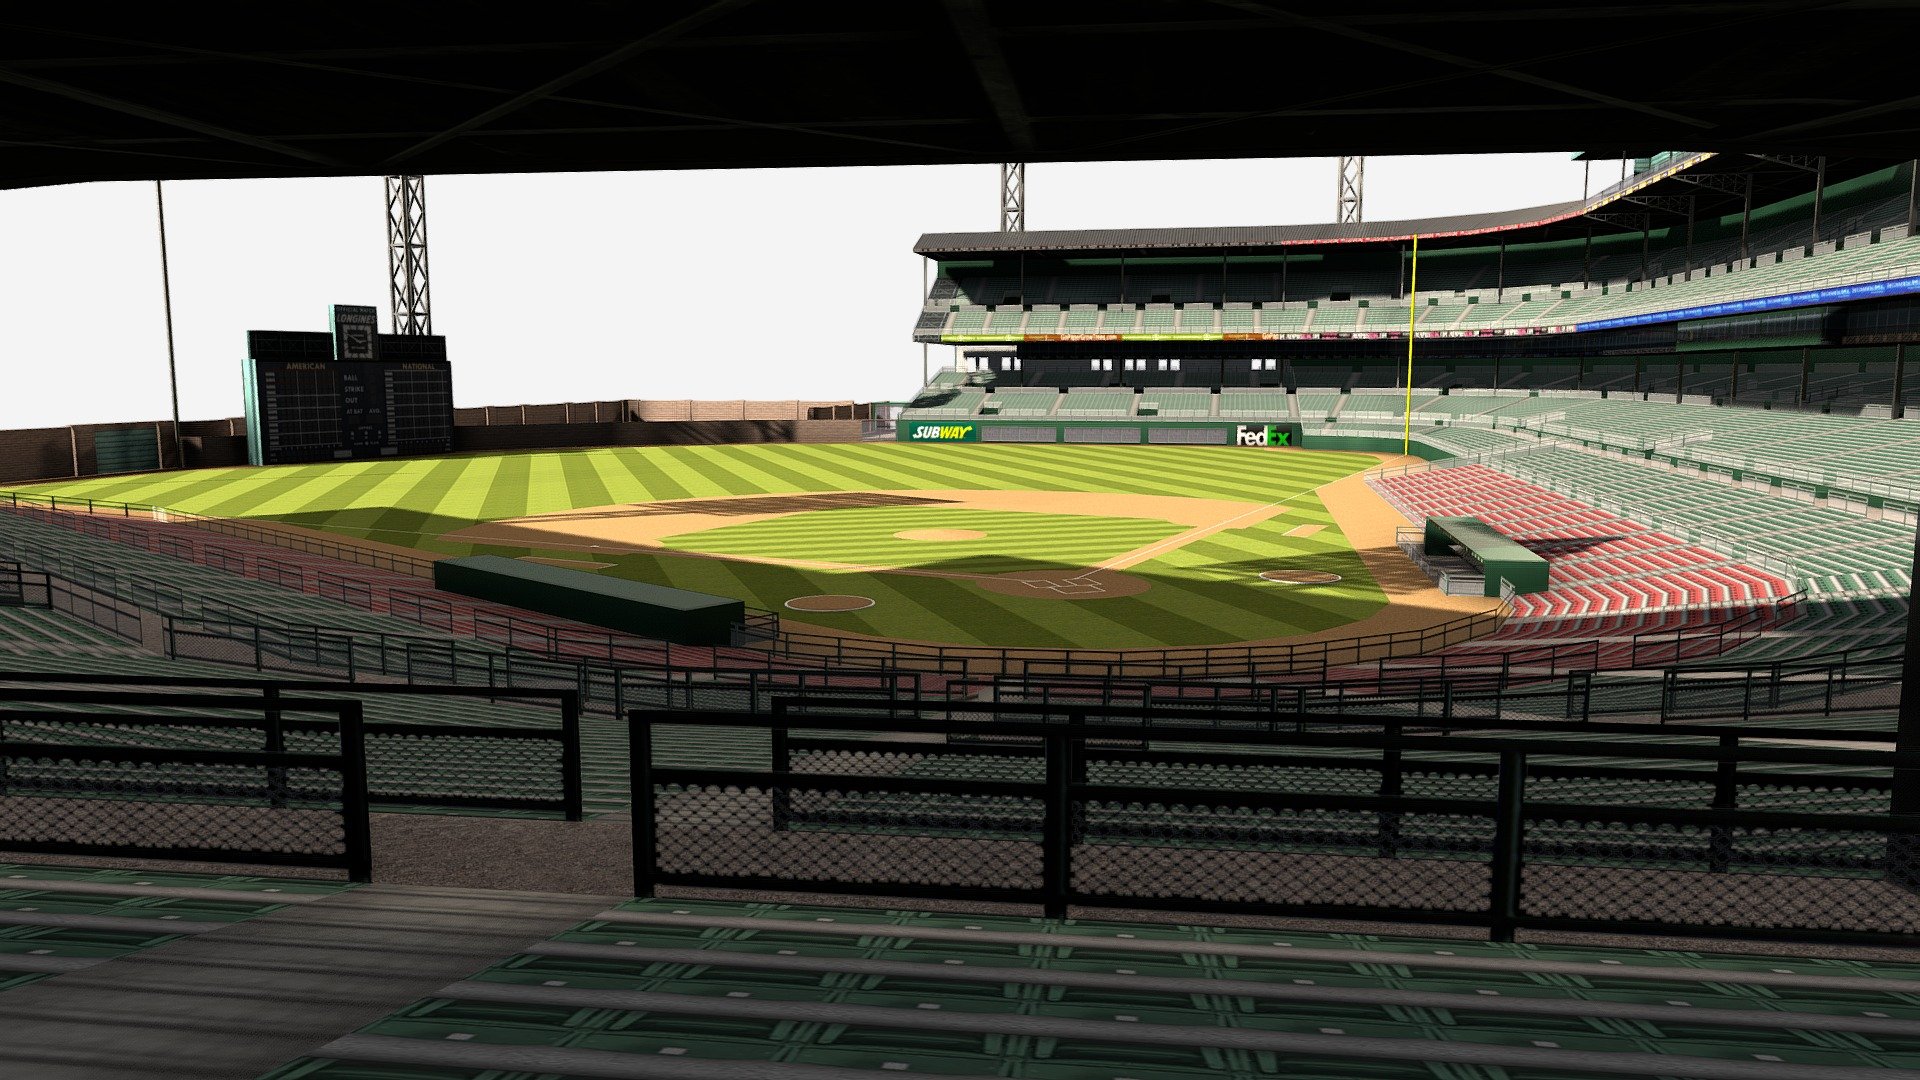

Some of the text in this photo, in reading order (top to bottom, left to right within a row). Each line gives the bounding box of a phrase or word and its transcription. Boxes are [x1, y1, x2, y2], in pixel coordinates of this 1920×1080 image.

[337, 314, 375, 324] LONGINES
[286, 361, 326, 370] AMERICAN
[402, 361, 434, 370] NATIONAL
[344, 385, 364, 393] STRIKE
[912, 425, 972, 439] SUBWAY
[1237, 425, 1289, 446] FedEx
